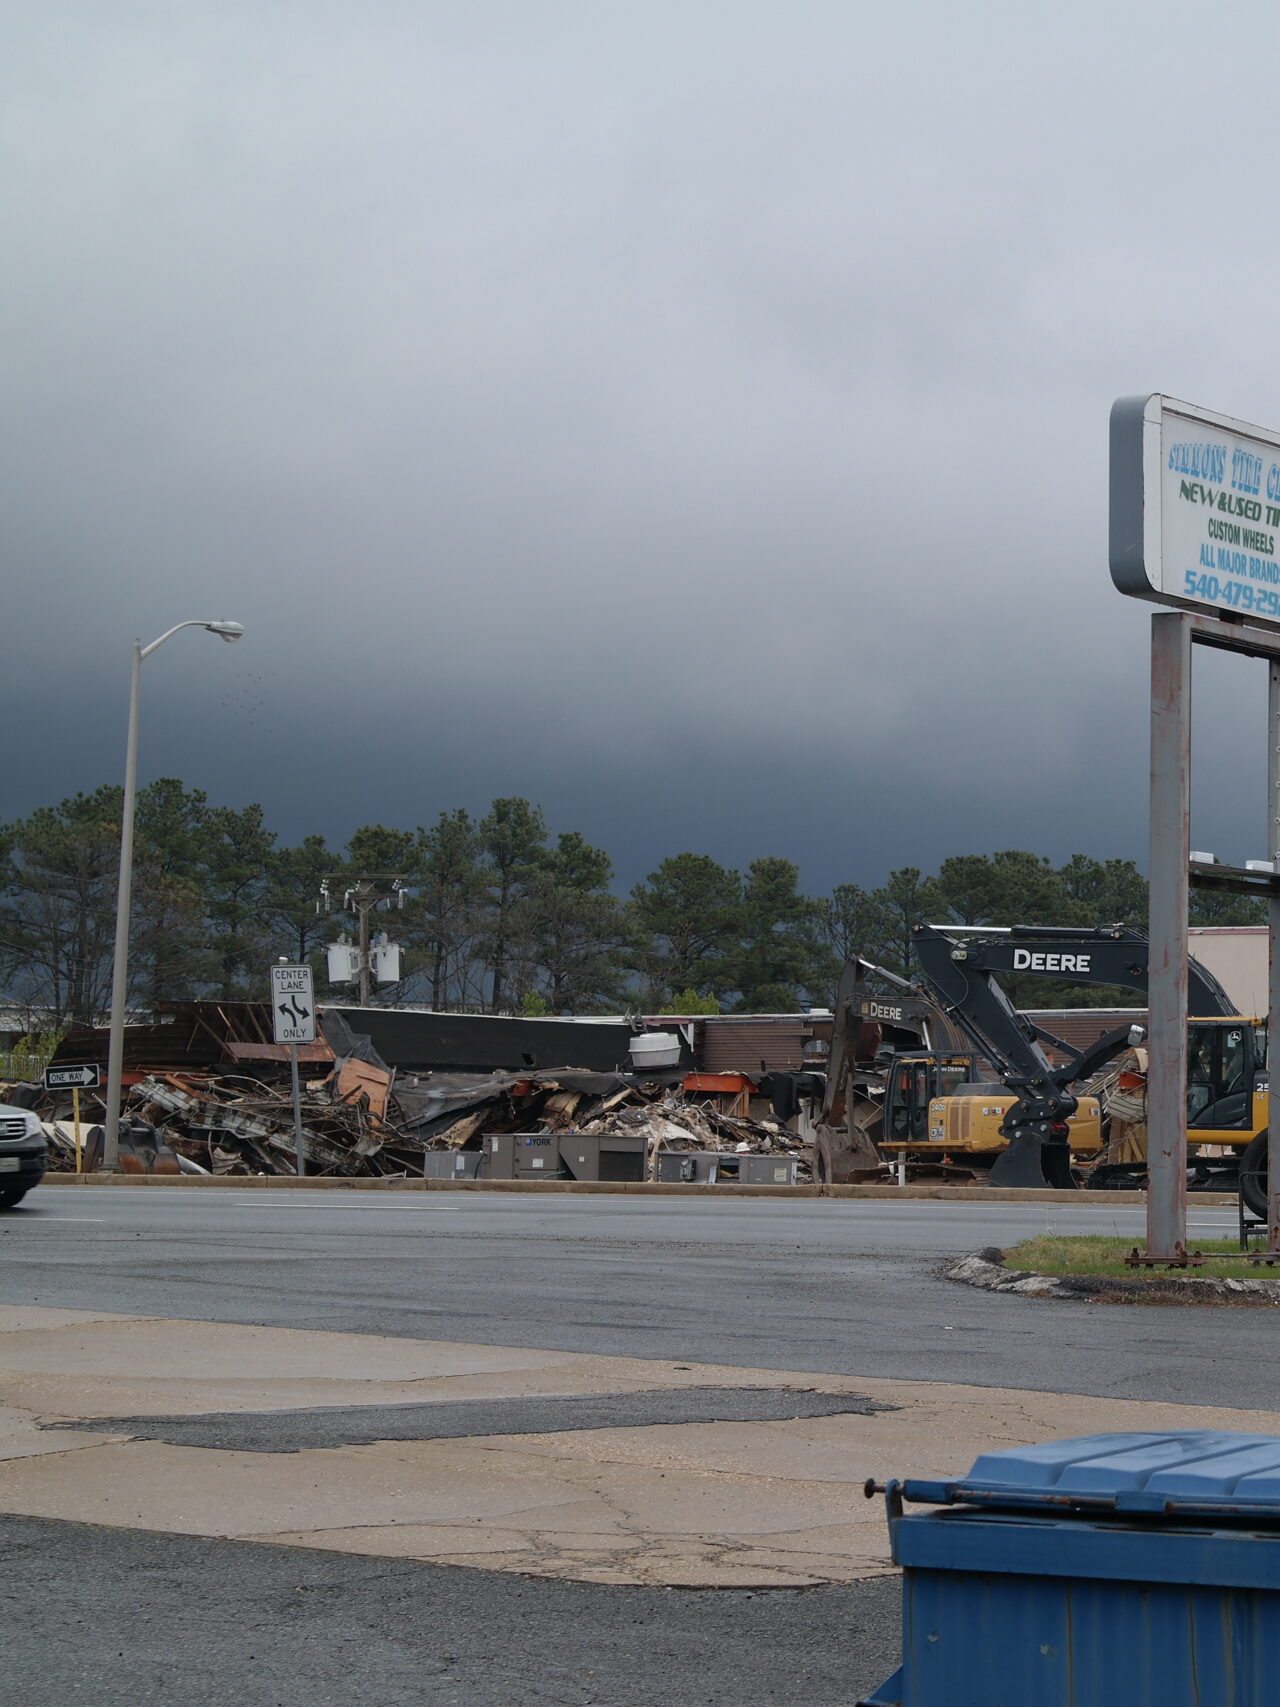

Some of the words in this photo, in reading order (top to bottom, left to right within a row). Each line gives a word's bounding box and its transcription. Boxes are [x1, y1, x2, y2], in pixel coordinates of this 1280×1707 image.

[1168, 443, 1227, 484] SIMMONS
[1231, 448, 1263, 495] TIRE
[1208, 518, 1241, 546] CUSTOM
[1242, 527, 1275, 555] WHEELS
[1200, 543, 1216, 569] ALL
[1217, 548, 1247, 577] MAJOR
[1013, 948, 1091, 973] DEERE
[275, 970, 309, 980] CENTER
[281, 980, 304, 990] LANE
[870, 1002, 902, 1021] DEERE
[283, 1029, 306, 1038] ONLY
[51, 1073, 66, 1082] ONE
[68, 1072, 82, 1081] WAY
[532, 1137, 552, 1146] YORK
